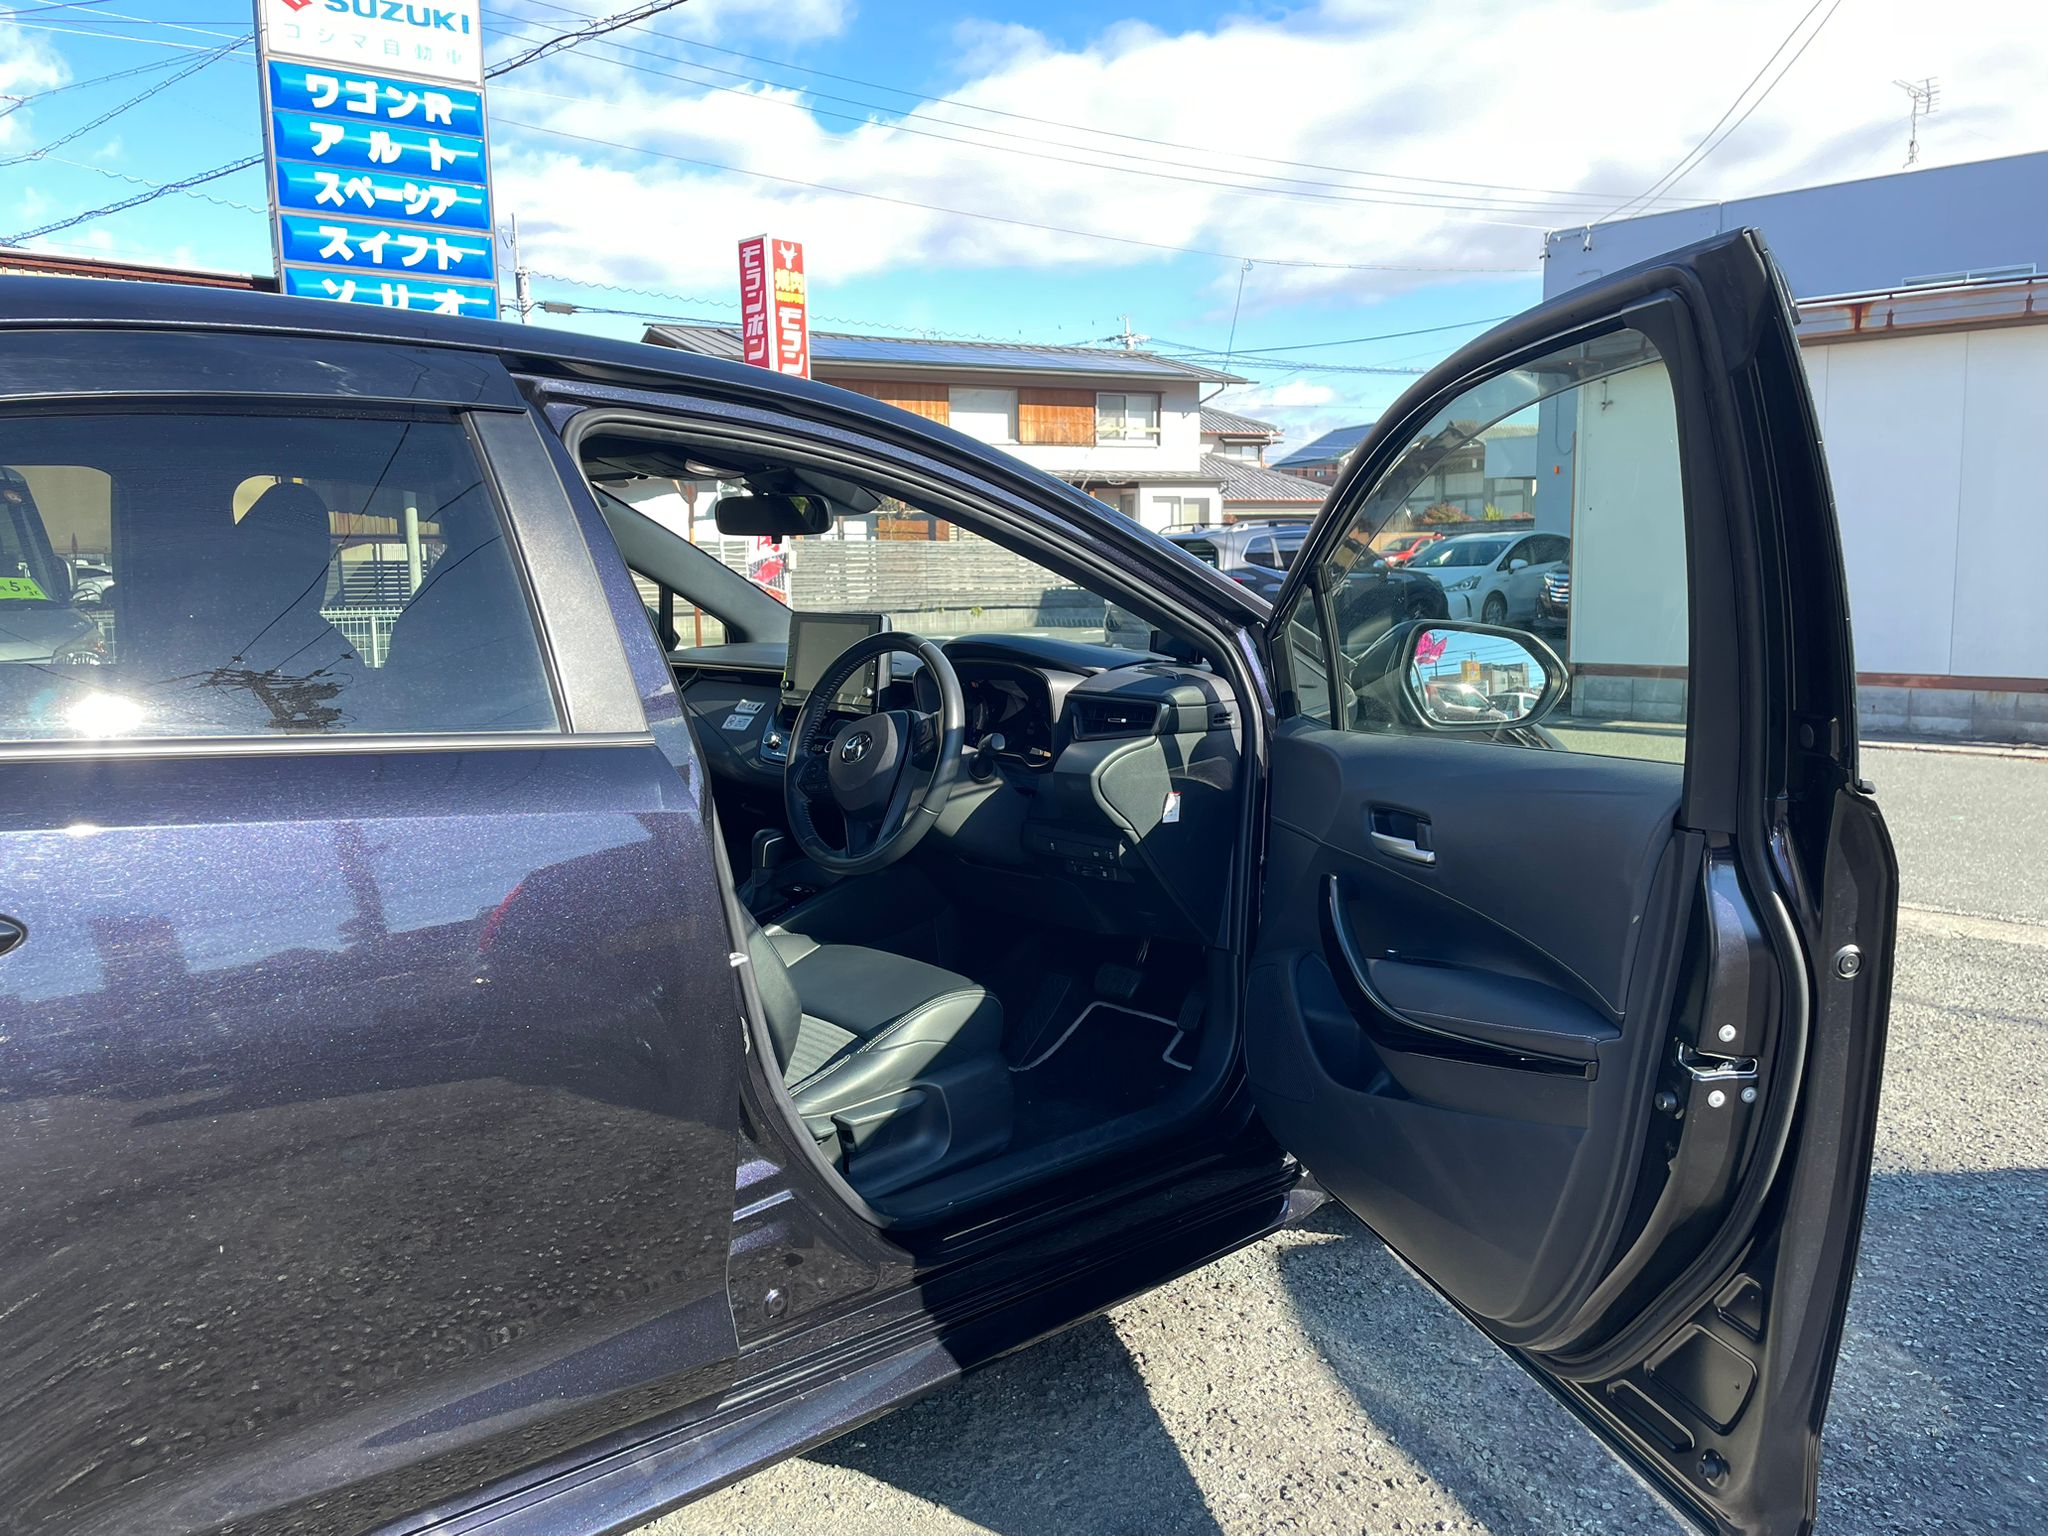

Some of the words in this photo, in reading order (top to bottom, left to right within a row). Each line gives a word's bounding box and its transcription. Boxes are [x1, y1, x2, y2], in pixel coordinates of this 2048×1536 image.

[305, 73, 453, 125] ワゴンR
[309, 121, 456, 172] アルト
[314, 171, 457, 219] スペーシア
[318, 225, 464, 271] スイフト
[321, 277, 466, 316] ソリオ
[742, 244, 765, 361] モランボン
[778, 305, 807, 378] モラン
